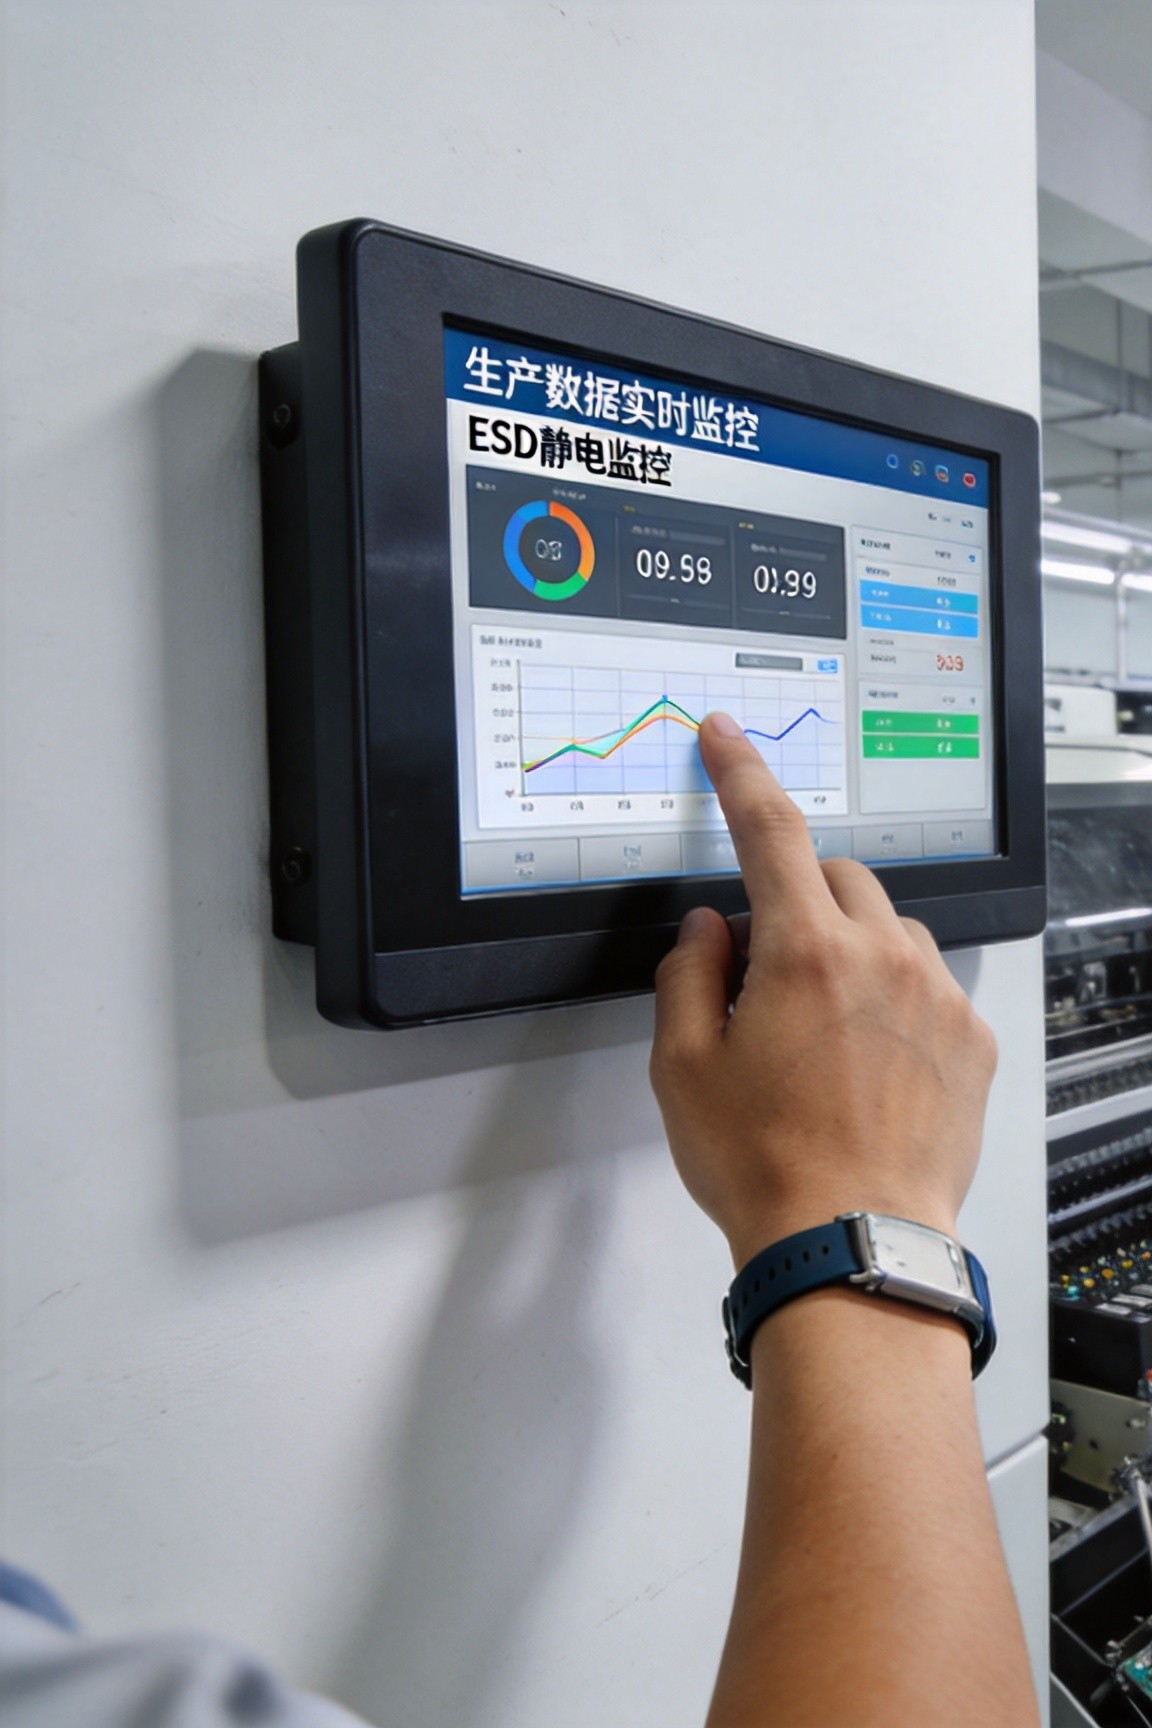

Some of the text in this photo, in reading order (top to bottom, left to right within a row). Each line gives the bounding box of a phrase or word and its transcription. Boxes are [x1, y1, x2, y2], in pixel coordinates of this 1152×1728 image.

[463, 346, 760, 452] 生产数据实时监控
[468, 415, 672, 487] ESD静电监控
